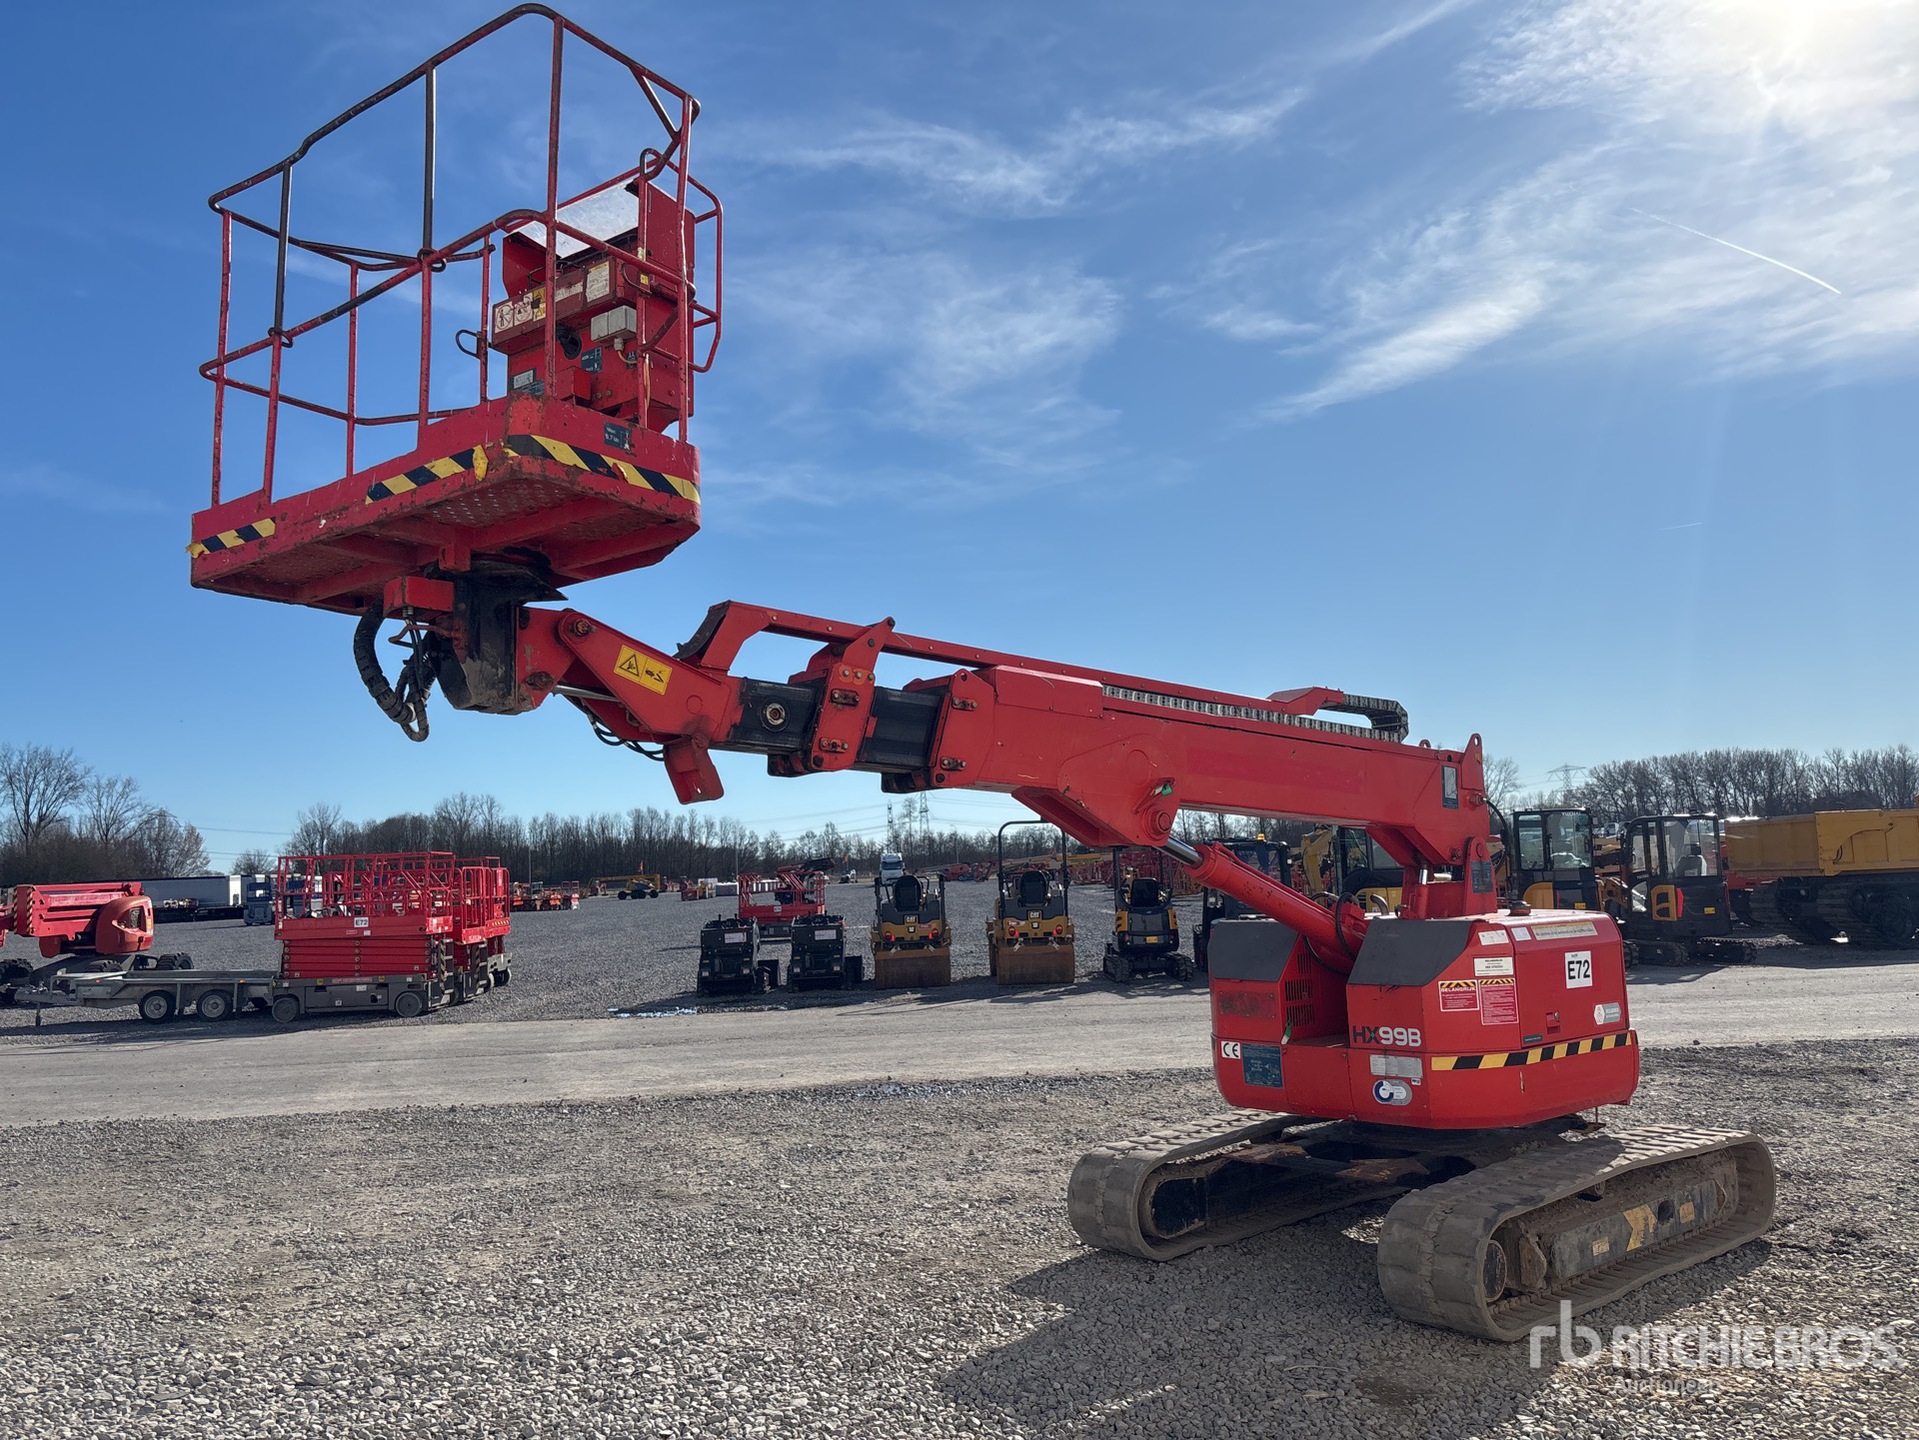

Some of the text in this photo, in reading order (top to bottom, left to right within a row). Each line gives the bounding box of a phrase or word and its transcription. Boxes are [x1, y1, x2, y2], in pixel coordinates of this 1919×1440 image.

[1567, 959, 1591, 980] E72
[1352, 1025, 1422, 1047] HX99B
[1222, 1042, 1240, 1058] CE
